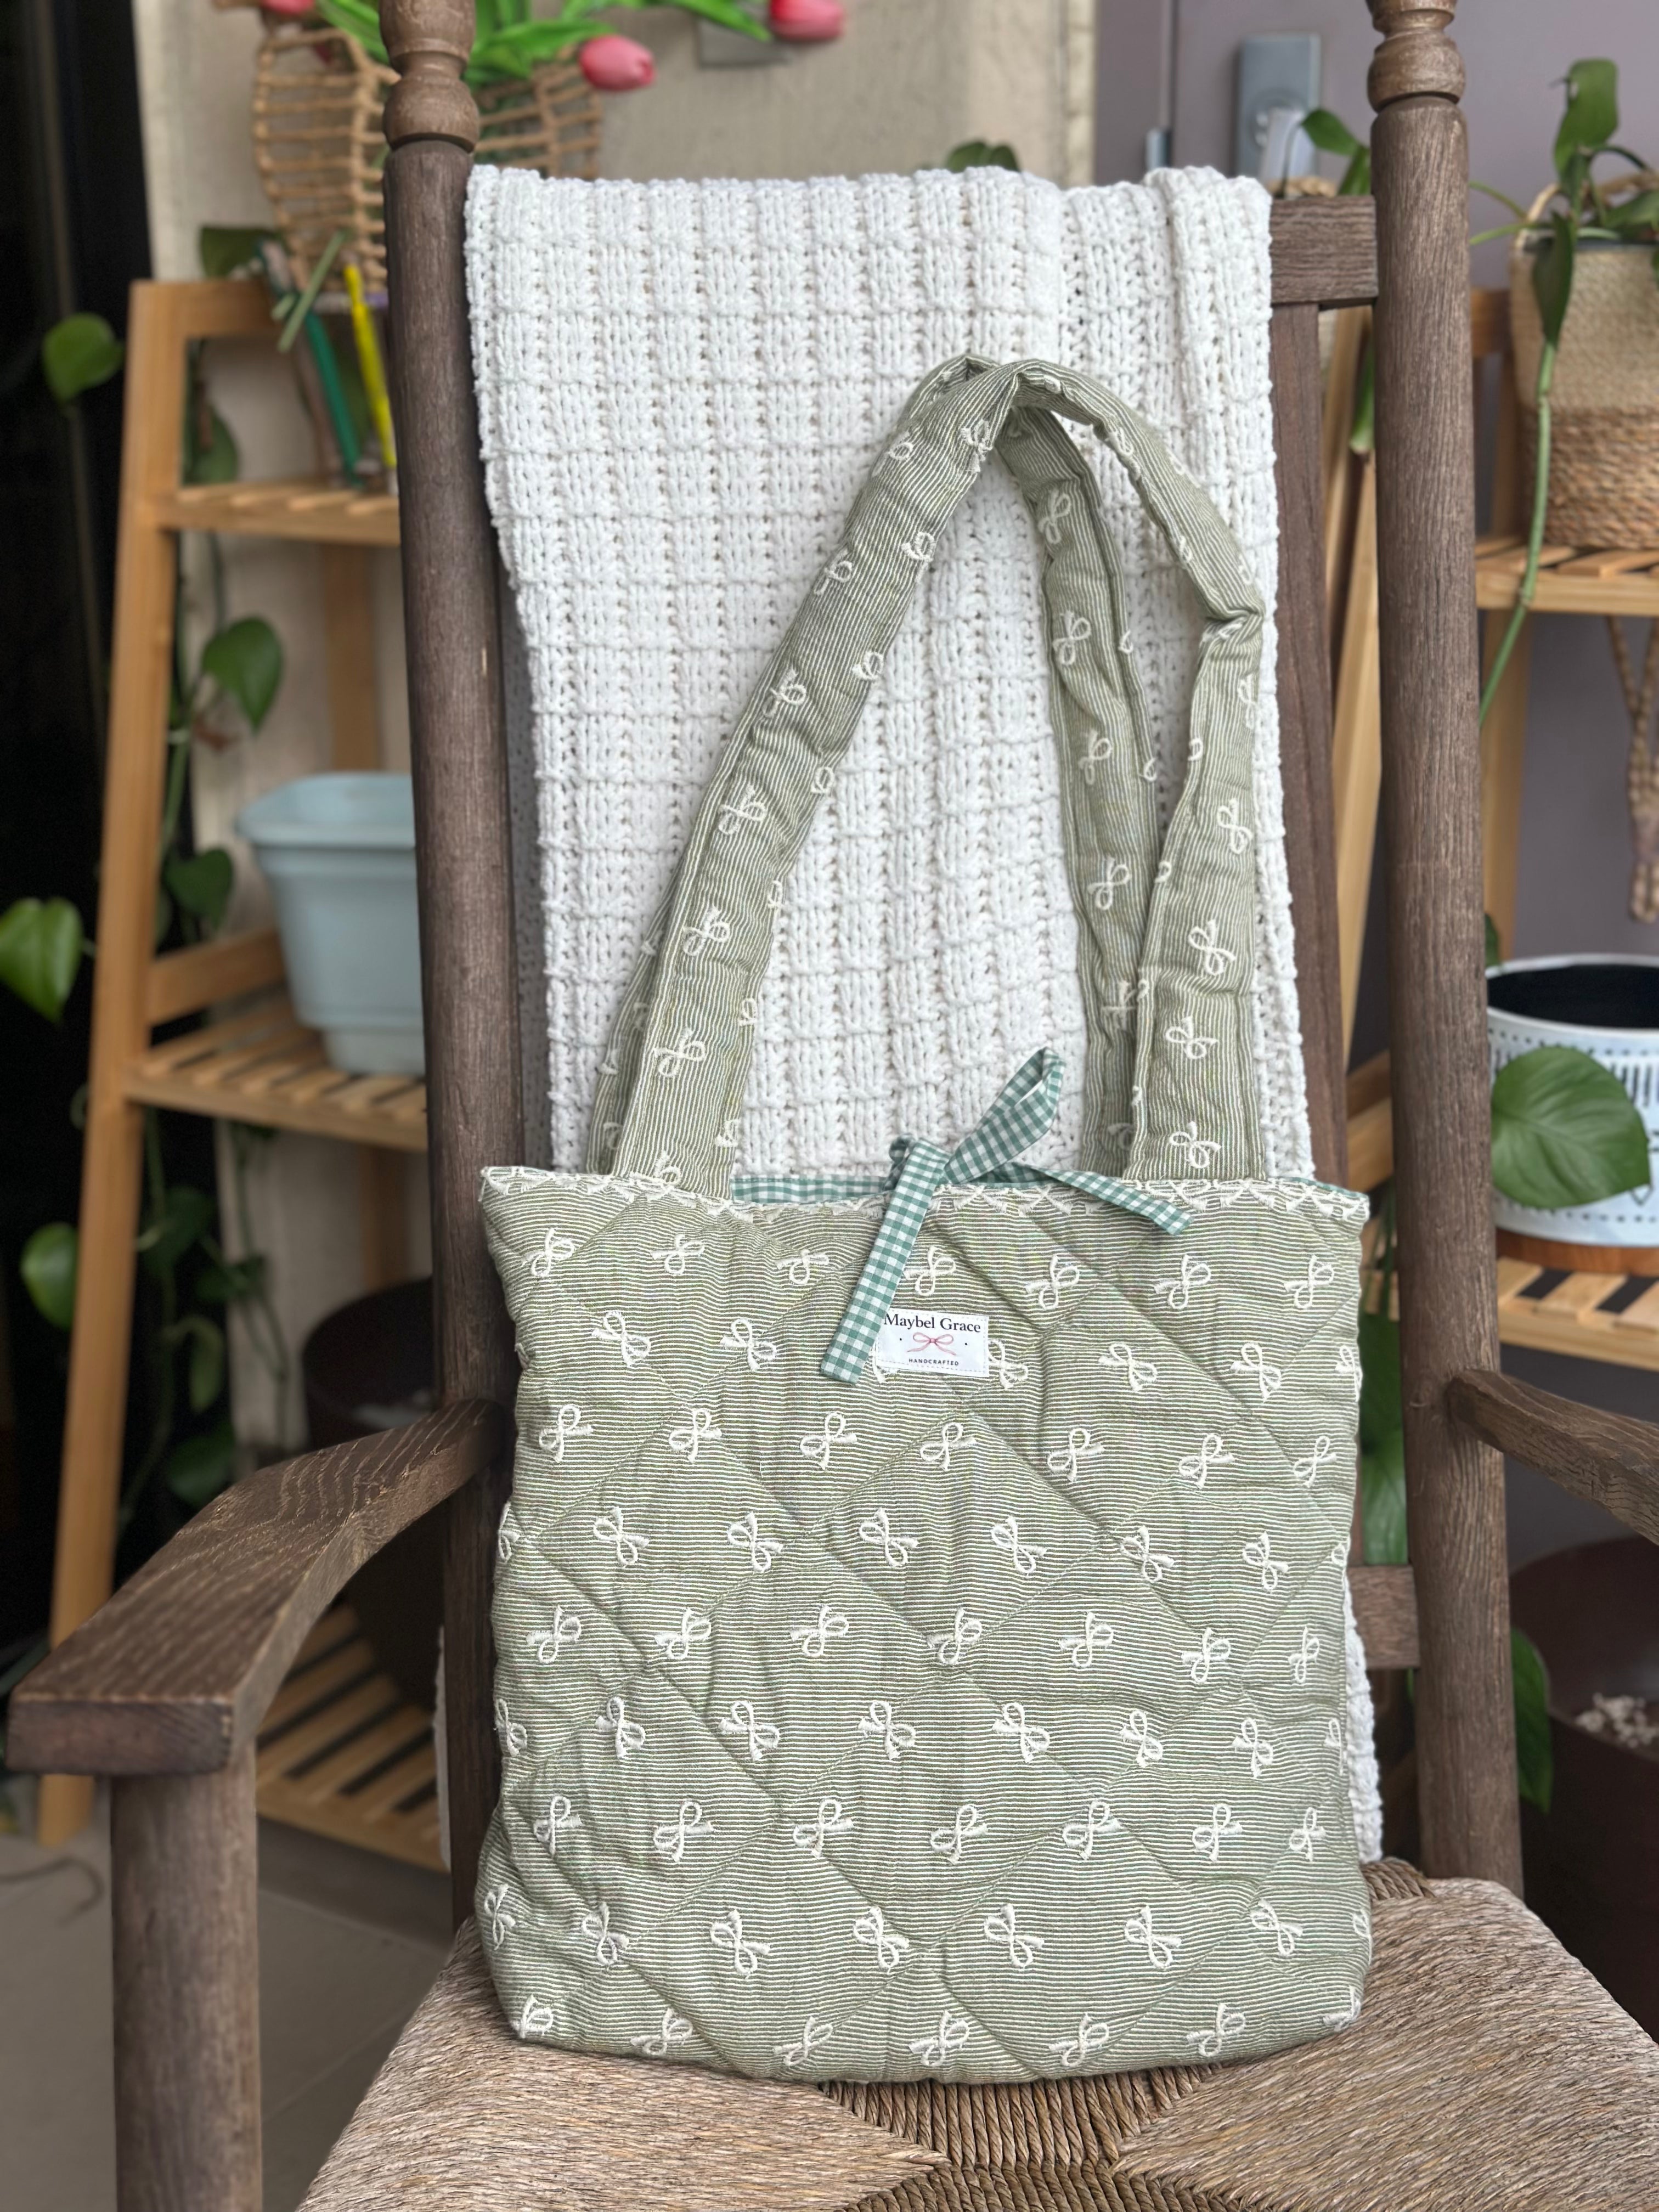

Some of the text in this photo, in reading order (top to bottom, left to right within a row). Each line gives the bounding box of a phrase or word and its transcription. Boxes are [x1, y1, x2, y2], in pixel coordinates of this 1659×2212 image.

[884, 1313, 981, 1333] Maybel Grace
[909, 1358, 959, 1366] HANDCRAFTED
